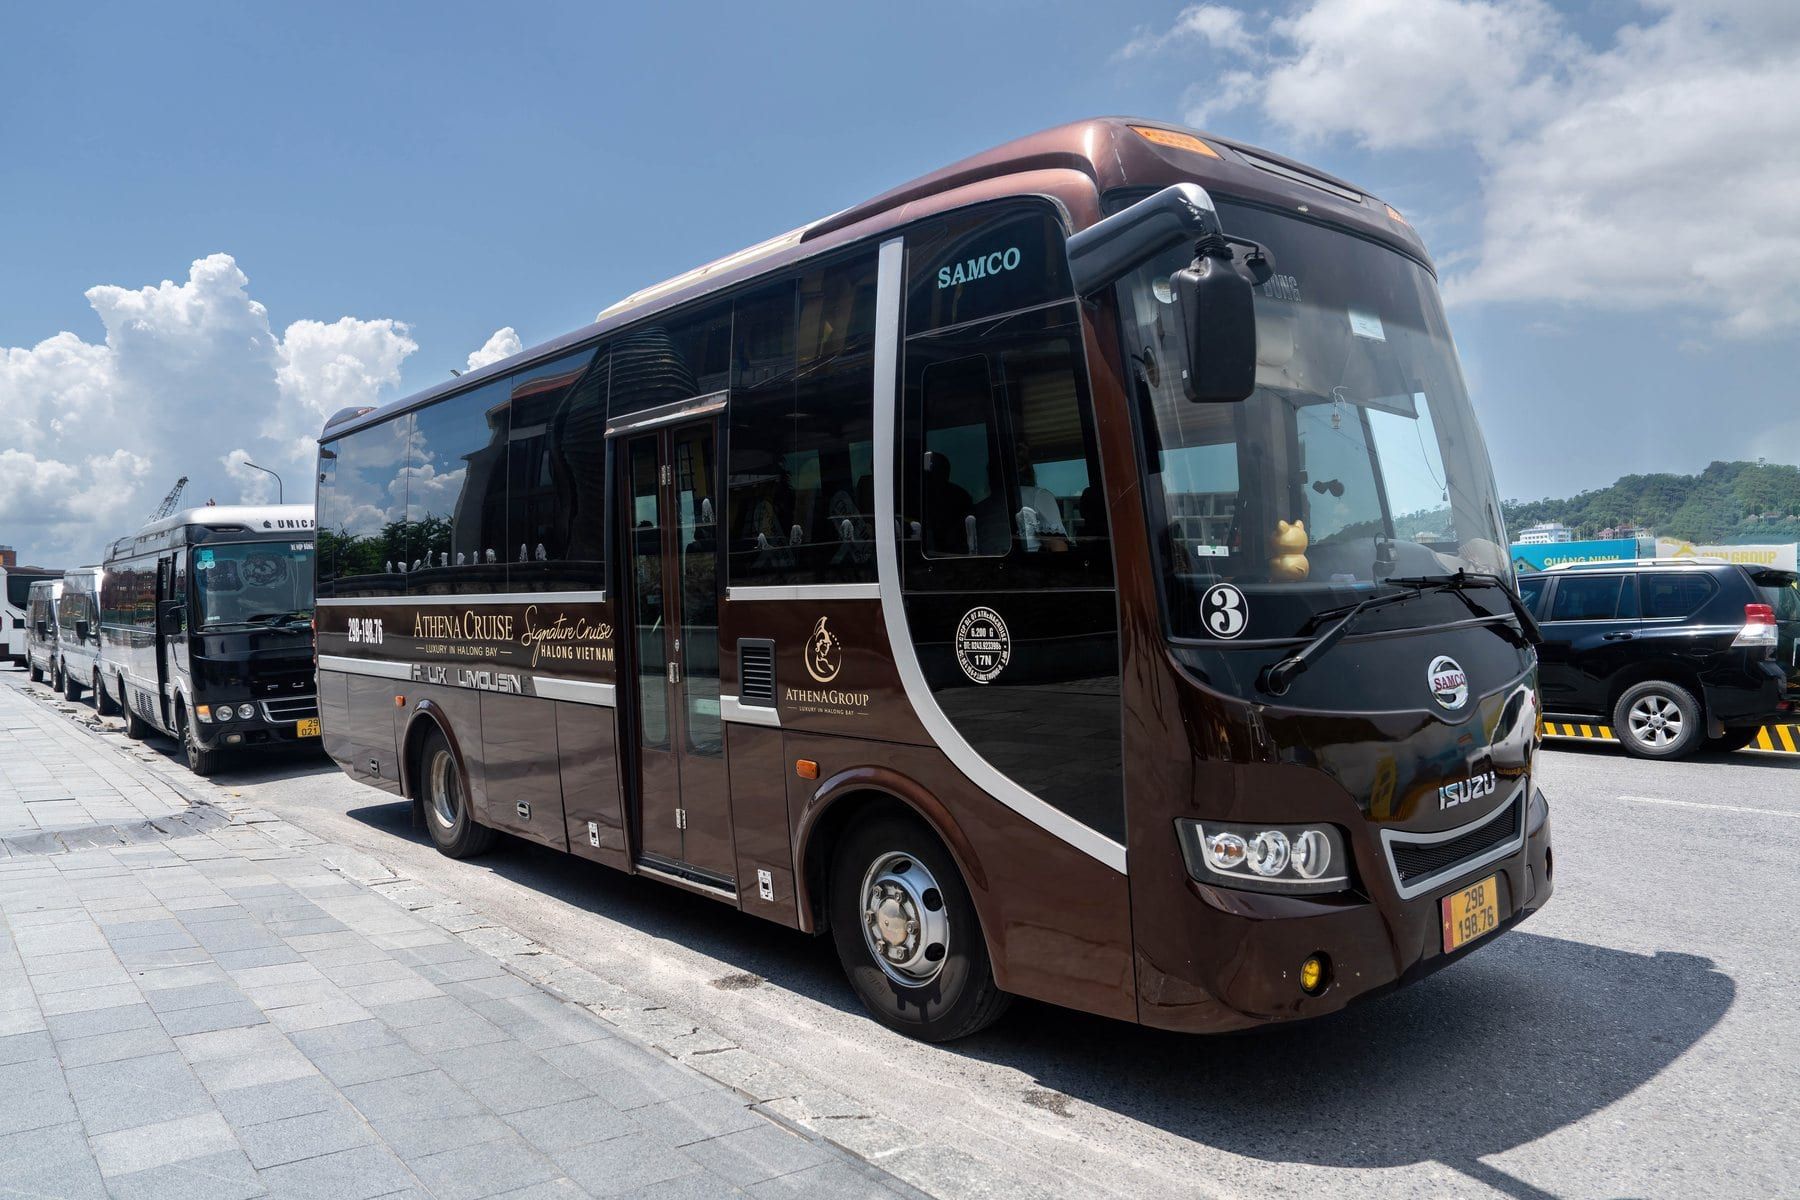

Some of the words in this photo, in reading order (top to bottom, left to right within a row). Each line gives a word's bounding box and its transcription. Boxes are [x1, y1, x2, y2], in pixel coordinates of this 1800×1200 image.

[938, 247, 1020, 289] SAMCO
[1731, 551, 1777, 564] GROUP
[414, 611, 461, 639] ATHENA
[464, 610, 514, 640] CRUISE
[1210, 588, 1243, 634] 3
[425, 644, 447, 654] LUXURY
[458, 646, 483, 656] HALONG
[485, 647, 498, 657] BAY
[521, 604, 576, 668] Signature
[576, 617, 614, 640] Cruise
[541, 645, 573, 659] HALONG
[576, 646, 614, 662] VIETNAM
[974, 654, 992, 666] 17N
[1433, 673, 1465, 691] SAMCO
[1438, 770, 1496, 811] ISUZU
[1464, 884, 1485, 914] 29B
[1458, 905, 1494, 943] 198.76
